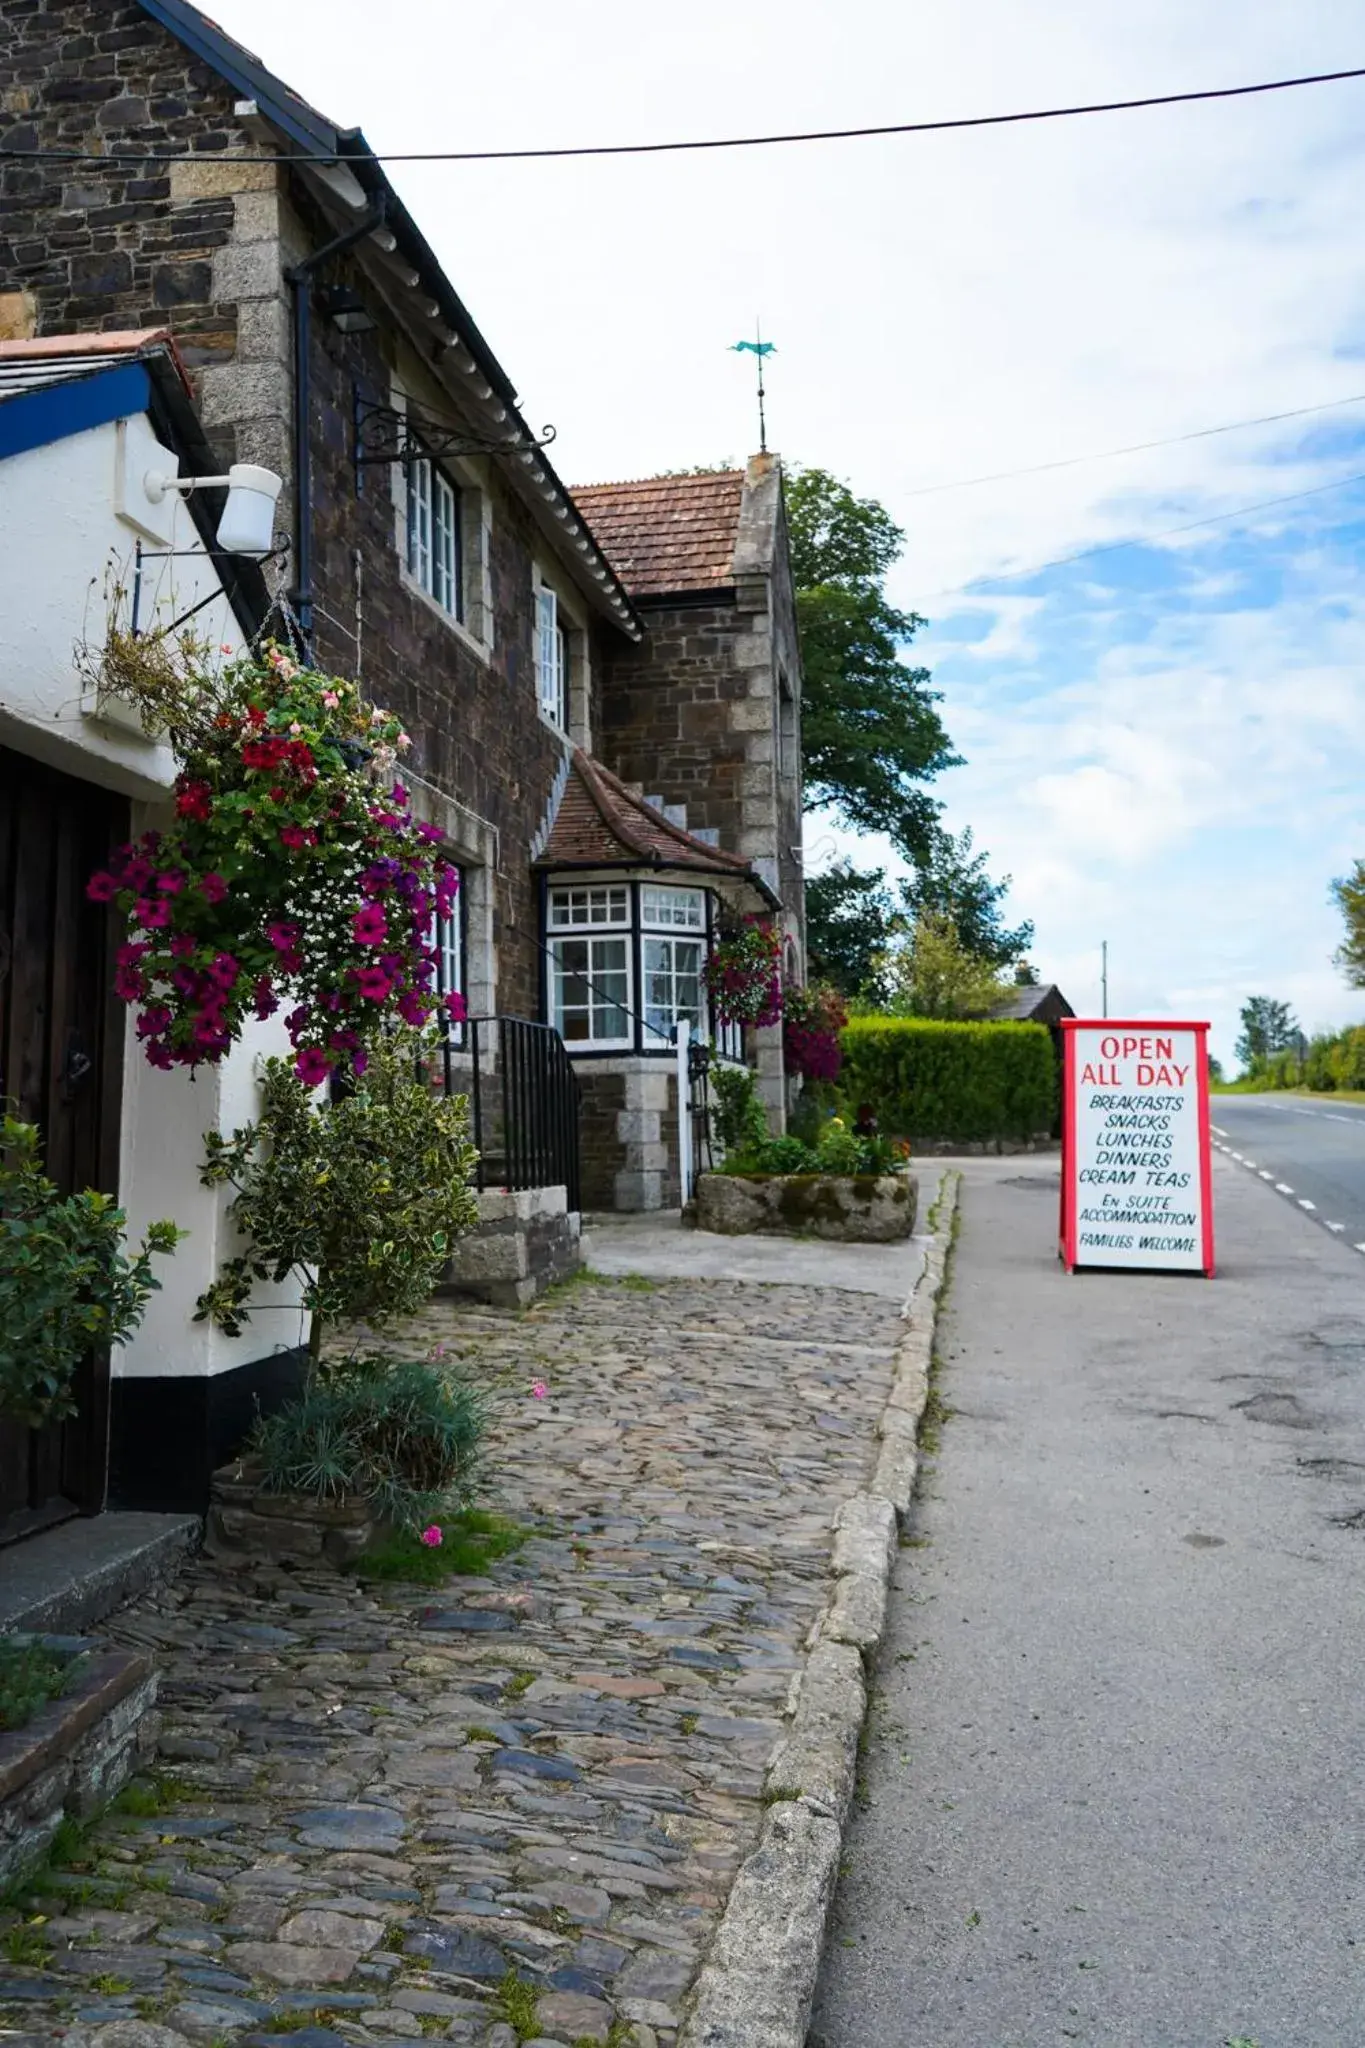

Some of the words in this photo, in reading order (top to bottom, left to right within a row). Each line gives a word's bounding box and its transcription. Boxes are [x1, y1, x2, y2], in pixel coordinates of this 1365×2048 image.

[1101, 1037, 1173, 1060] OPEN
[1081, 1064, 1122, 1085] ALL
[1137, 1065, 1190, 1086] DAY
[1090, 1095, 1184, 1111] BREAKFASTS
[1104, 1115, 1171, 1130] SNACKS
[1096, 1133, 1174, 1148] LUNCHES
[1096, 1151, 1172, 1168] DINNERS
[1079, 1169, 1136, 1186] CREAM
[1146, 1172, 1191, 1188] TEAS
[1126, 1195, 1172, 1209] SUITE
[1079, 1209, 1196, 1226] ACCOMMODATION
[1079, 1234, 1133, 1248] FAMILIES
[1139, 1236, 1196, 1252] WELCOME
